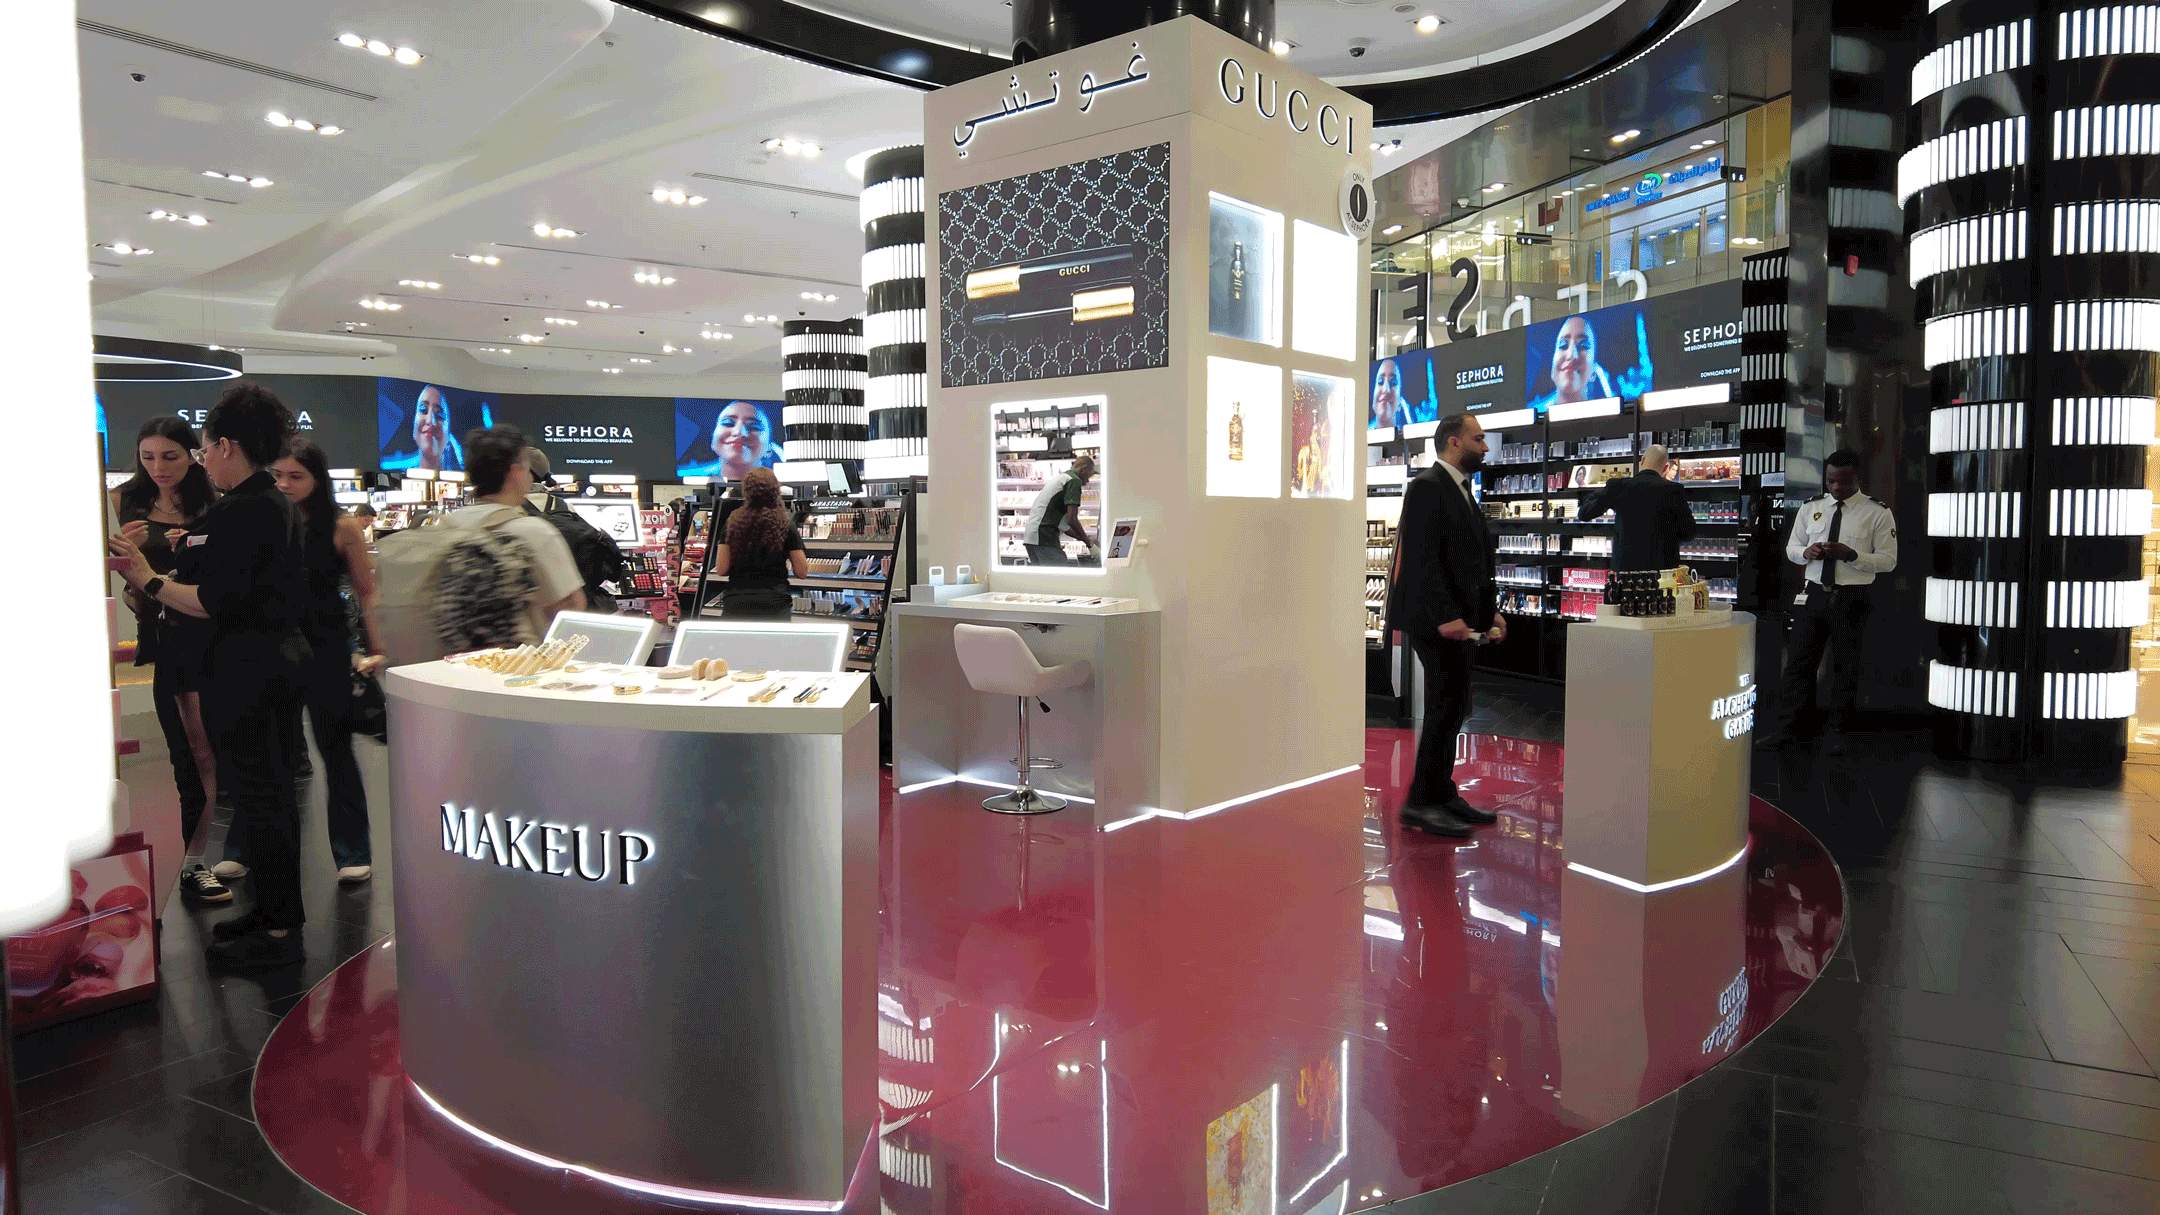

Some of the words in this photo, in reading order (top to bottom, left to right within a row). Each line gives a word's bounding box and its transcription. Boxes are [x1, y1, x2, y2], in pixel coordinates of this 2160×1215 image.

[1218, 58, 1353, 156] GUCCI
[1059, 264, 1090, 276] GUCCI
[1456, 364, 1504, 385] SEPHORA
[544, 425, 633, 438] SEPHORA
[439, 803, 655, 886] MAKEUP
